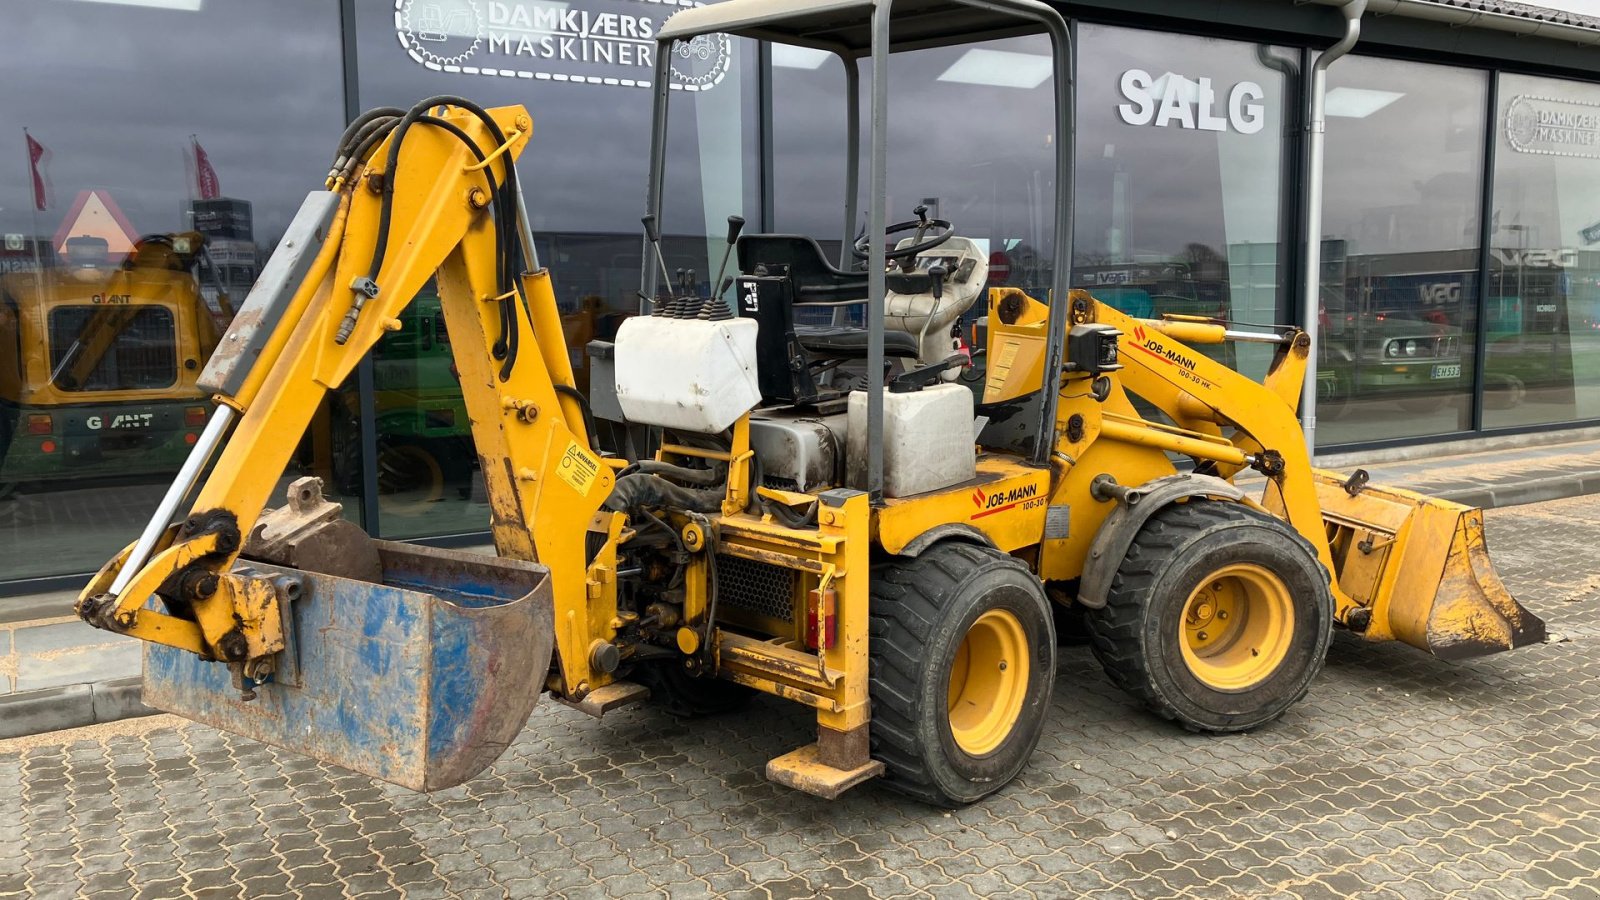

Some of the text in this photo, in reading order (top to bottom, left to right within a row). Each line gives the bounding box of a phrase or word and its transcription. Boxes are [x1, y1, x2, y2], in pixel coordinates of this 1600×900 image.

[488, 2, 653, 38] DAMKJÆRS
[488, 31, 653, 66] MASKINER
[1119, 69, 1264, 134] SALG
[1143, 340, 1196, 370] JOB-MANN
[1178, 369, 1200, 384] 100-30
[986, 483, 1037, 509] JOB-MANN
[1023, 499, 1044, 511] 100-30
